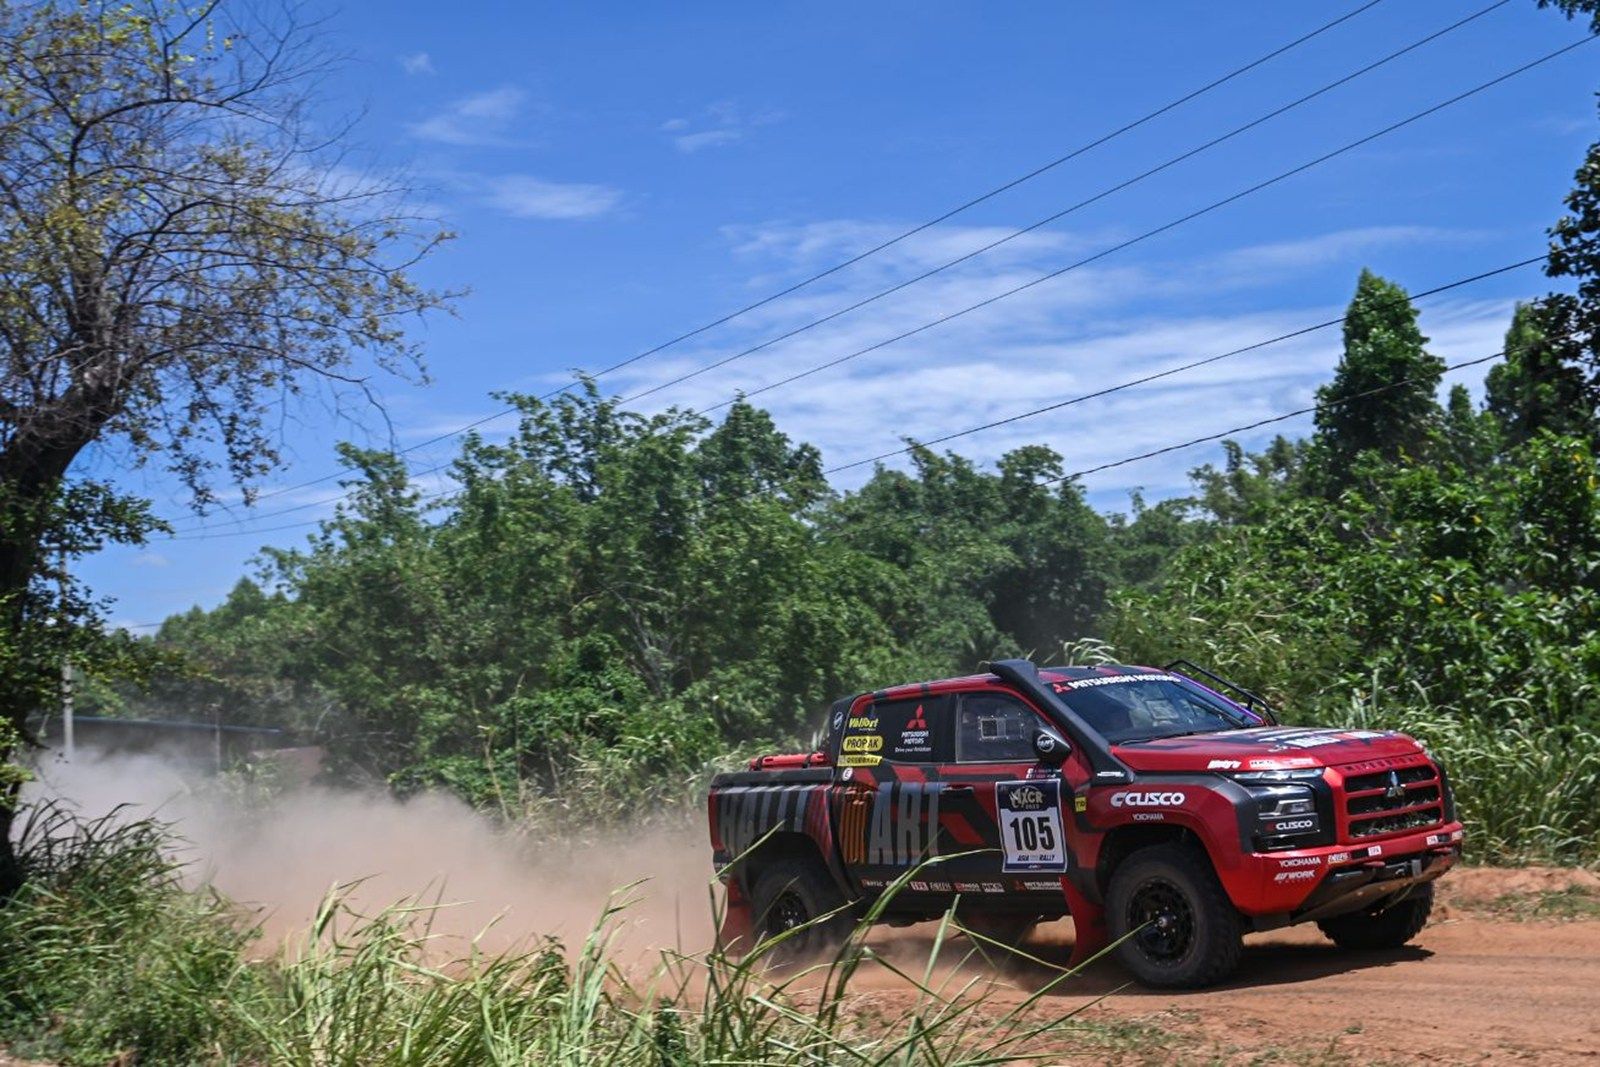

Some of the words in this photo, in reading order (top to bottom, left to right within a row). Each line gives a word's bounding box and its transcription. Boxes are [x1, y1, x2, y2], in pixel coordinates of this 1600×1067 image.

[1132, 813, 1164, 821] YOKOHAMA
[1276, 820, 1313, 831] CUSCO
[1010, 817, 1055, 851] 105
[1279, 856, 1321, 868] YOKOHAMA
[1288, 870, 1315, 880] WORK
